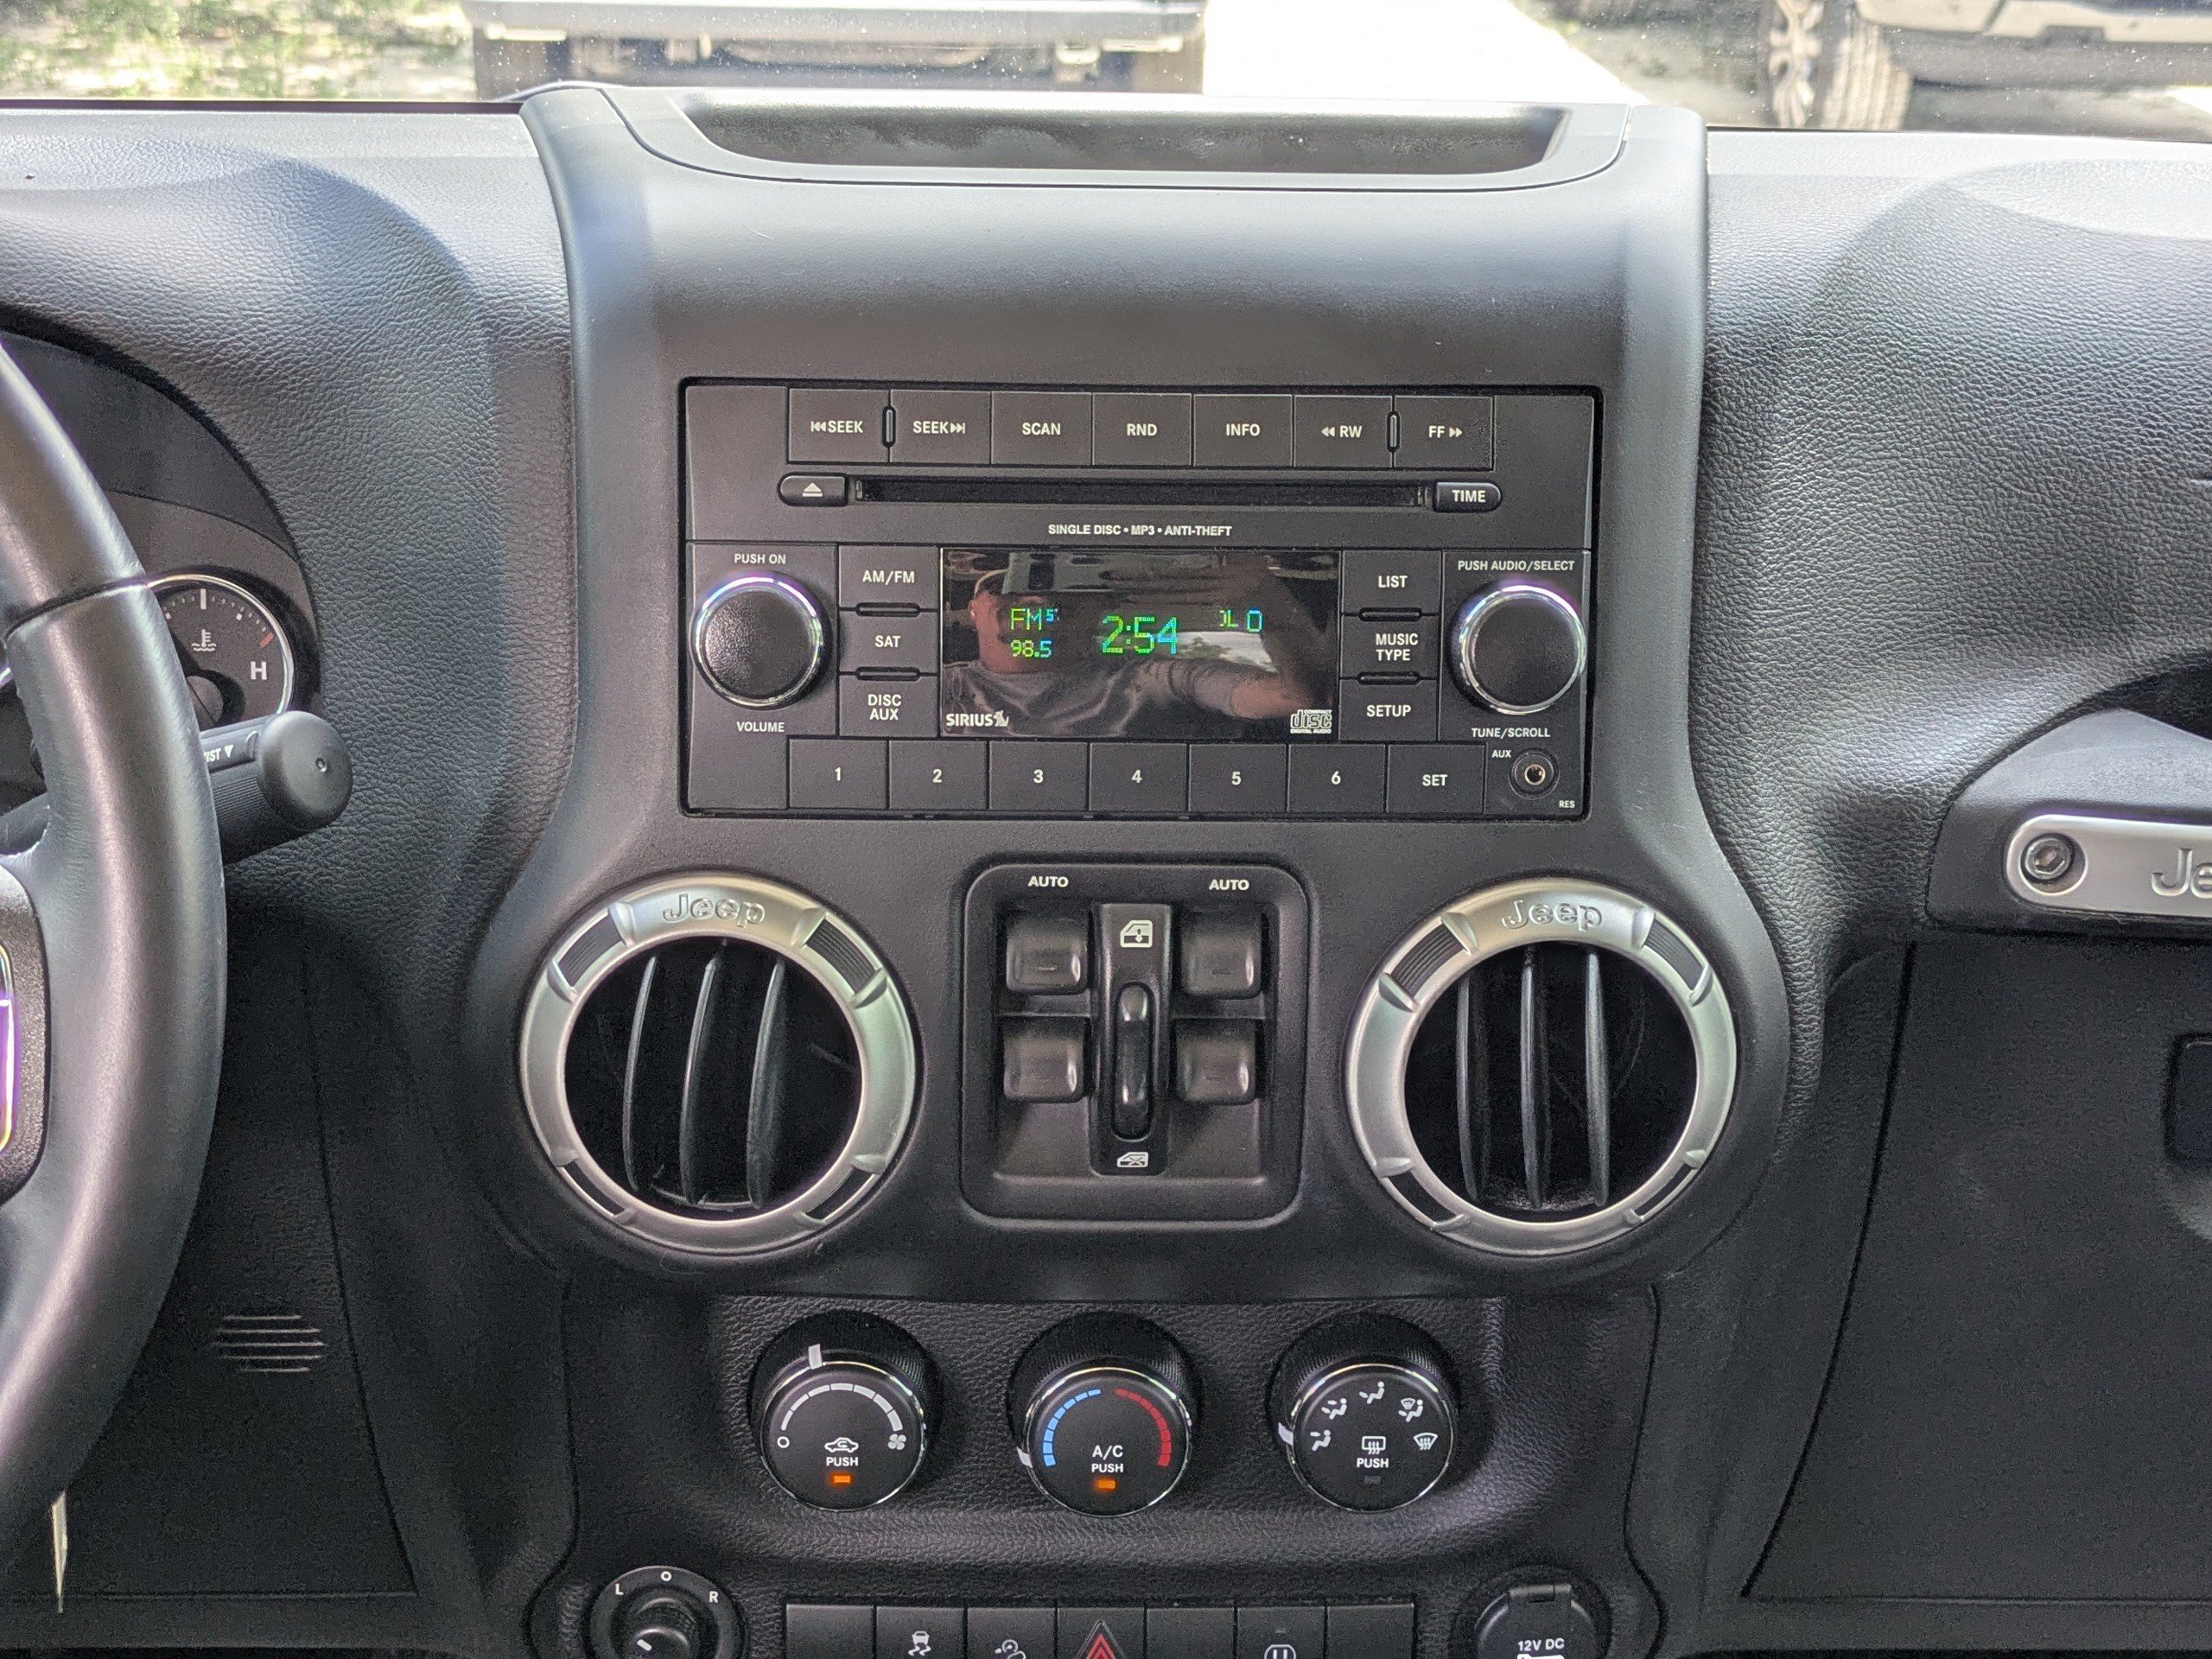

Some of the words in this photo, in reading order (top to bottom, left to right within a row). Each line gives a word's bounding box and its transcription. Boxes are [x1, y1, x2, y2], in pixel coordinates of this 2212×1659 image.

[827, 420, 864, 434] SEEK
[912, 420, 949, 435] SEEK
[1021, 422, 1061, 436] SCAN
[1126, 423, 1158, 436] RND
[1226, 423, 1261, 436] INFO
[1339, 425, 1363, 438] RW
[1428, 425, 1446, 438] FF
[1452, 488, 1486, 504] TIME
[1048, 524, 1091, 535] SINGLE
[1093, 524, 1122, 536] DISC
[1130, 524, 1155, 536] MP3
[1164, 524, 1233, 537] ANTI-THEFT
[734, 553, 766, 564] PUSH
[768, 553, 786, 564] ON
[1458, 560, 1489, 571] PUSH
[1491, 560, 1575, 573] AUDIO/SELECT
[861, 569, 915, 586] AM/FM
[1378, 575, 1408, 588] LIST
[874, 634, 901, 648] SAT
[1101, 614, 1179, 655] 2:54
[1375, 632, 1419, 645] MUSIC
[1010, 639, 1053, 658] 98.5
[1376, 648, 1411, 661] TYPE
[250, 661, 268, 680] H
[868, 694, 902, 707] DISC
[869, 708, 899, 721] AUX
[1366, 704, 1412, 717] SETUP
[945, 713, 994, 727] SIRIUS
[736, 721, 785, 733] VOLUME
[1471, 727, 1551, 740] TUNE/SCROLL
[1491, 749, 1511, 759] AUX
[835, 766, 842, 781] 1
[932, 768, 943, 783] 2
[1033, 769, 1044, 784] 3
[1131, 769, 1143, 784] 4
[1231, 771, 1242, 785] 5
[1331, 771, 1341, 785] 6
[1422, 773, 1448, 787] SET
[1559, 799, 1575, 809] RES
[1027, 875, 1069, 887] AUTO
[1208, 879, 1249, 891] AUTO
[663, 893, 766, 928] Jeep
[1501, 899, 1603, 931] Jeep
[1092, 1445, 1123, 1460] A/C
[826, 1456, 859, 1467] PUSH
[1091, 1463, 1124, 1473] PUSH
[1356, 1457, 1389, 1469] PUSH
[615, 1583, 624, 1596] L
[709, 1591, 719, 1603] R
[1517, 1639, 1542, 1652] 12V
[1545, 1637, 1565, 1650] DC
